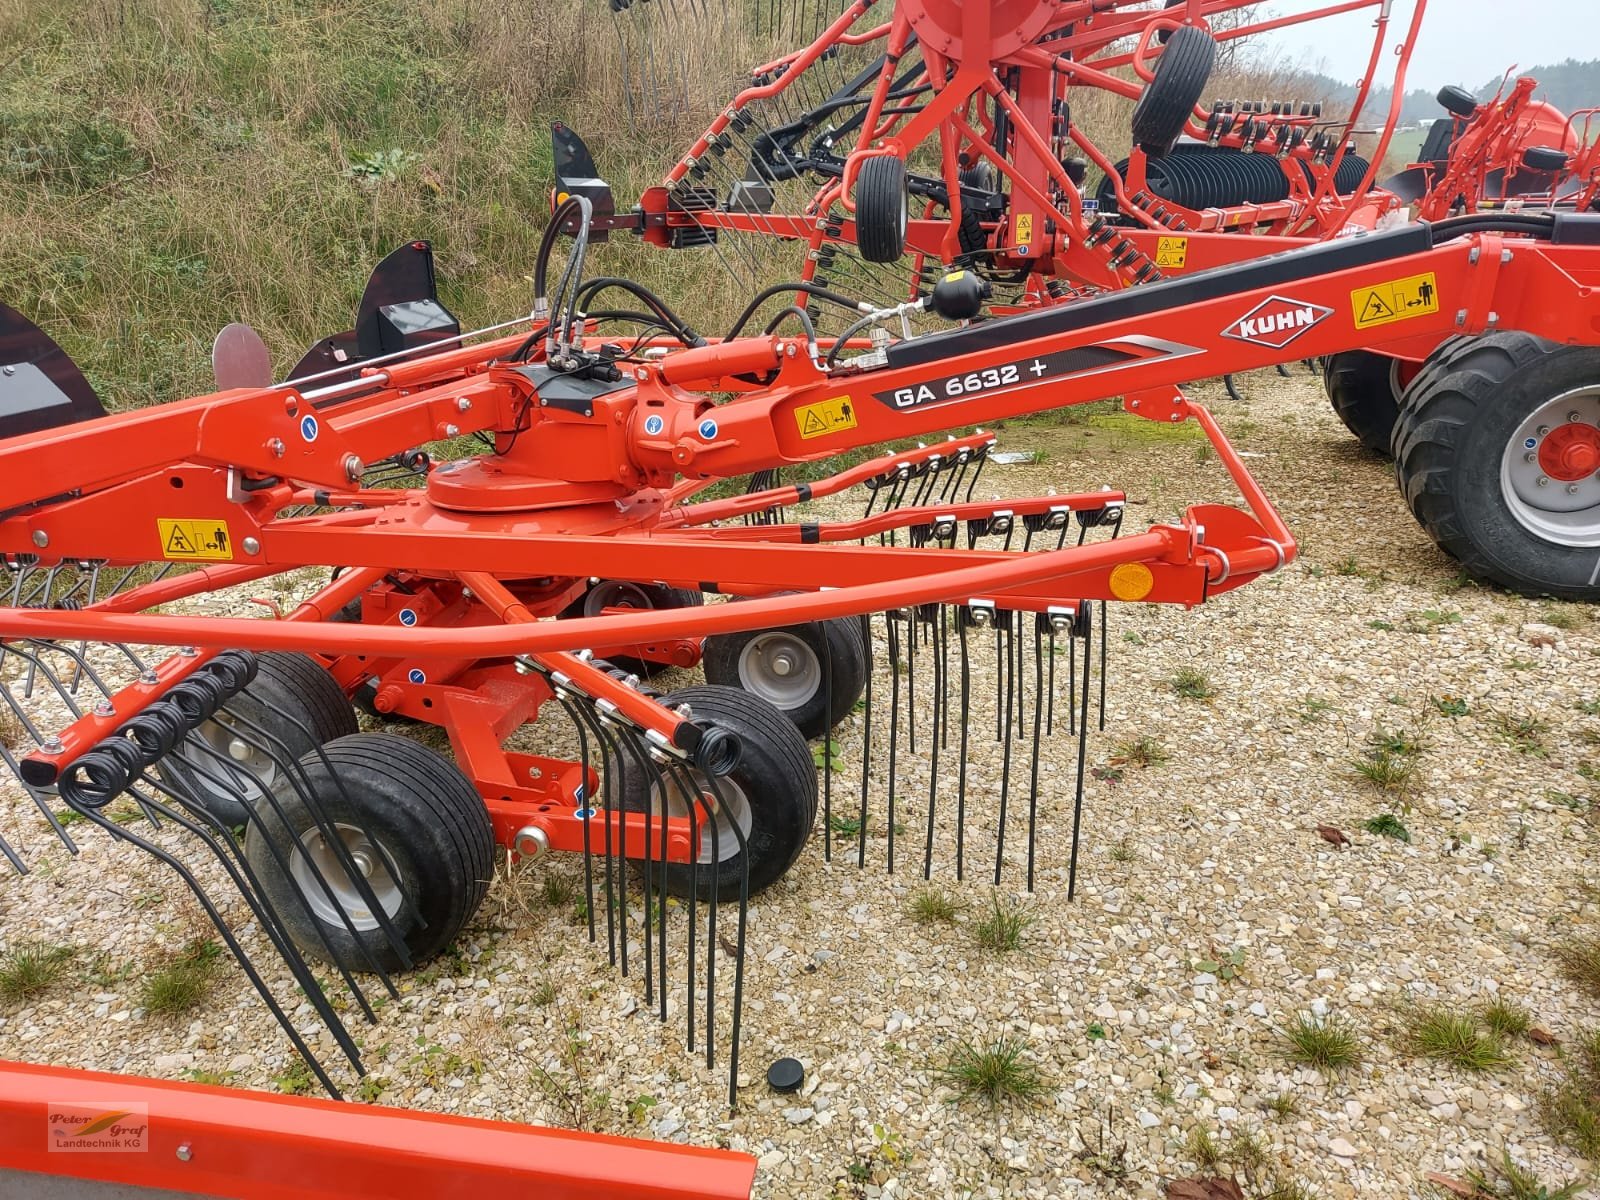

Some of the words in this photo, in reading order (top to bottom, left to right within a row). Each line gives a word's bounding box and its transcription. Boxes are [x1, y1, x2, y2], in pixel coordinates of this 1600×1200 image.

[1240, 307, 1314, 338] KUHN
[894, 385, 936, 407] GA
[945, 365, 1020, 396] 6632
[1029, 359, 1047, 377] +
